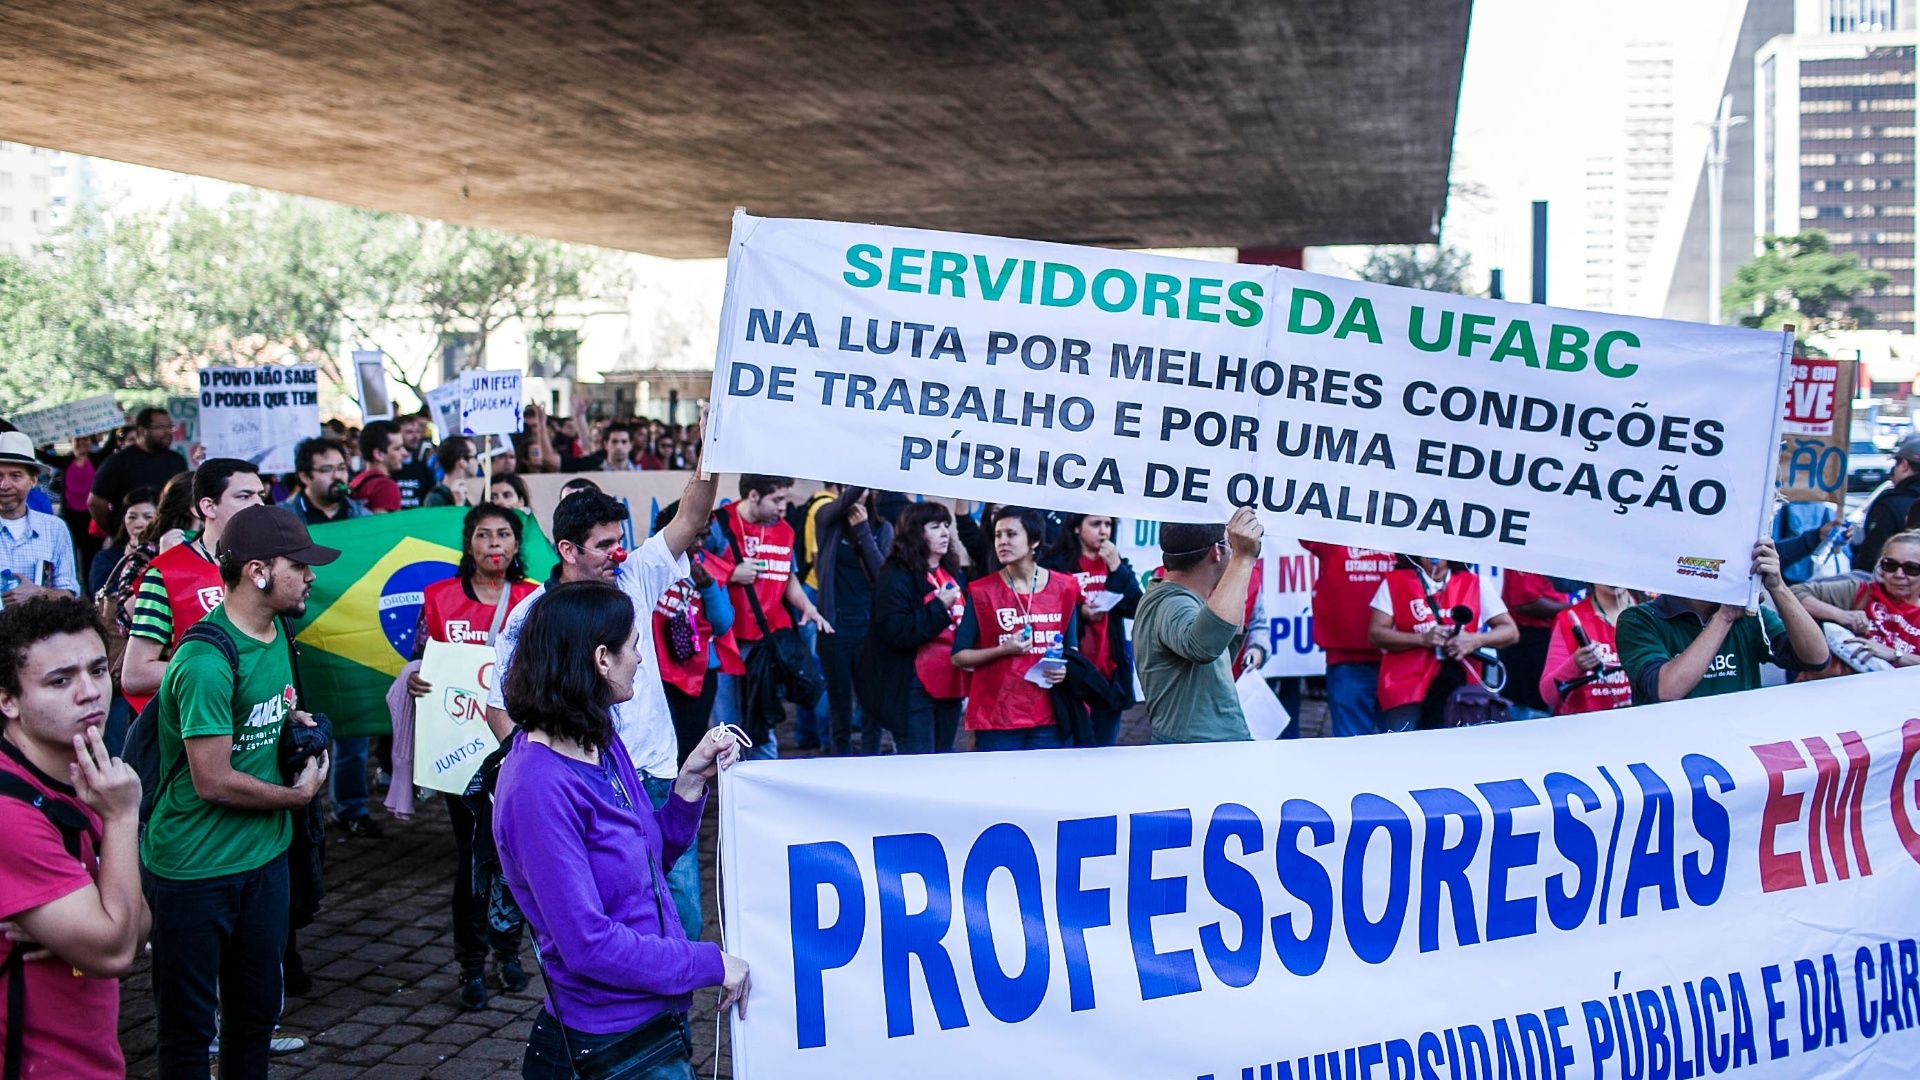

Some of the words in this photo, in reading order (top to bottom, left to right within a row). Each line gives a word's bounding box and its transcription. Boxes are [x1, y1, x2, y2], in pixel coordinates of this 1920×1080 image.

[843, 244, 1263, 327] SERVIDORES
[1288, 288, 1382, 344] DA
[1409, 306, 1640, 378] UFABC
[200, 370, 210, 387] O
[212, 370, 252, 387] POVO
[254, 365, 282, 386] NÃO
[285, 369, 317, 385] SABE
[472, 375, 519, 391] UNIFESP
[746, 308, 819, 347] NA
[839, 316, 966, 362] LUTA
[987, 331, 1091, 375] POR
[1110, 343, 1382, 409] MELHORES
[1403, 381, 1724, 456] CONDIÇÕES
[1812, 366, 1836, 381] em
[201, 391, 212, 407] O
[214, 391, 261, 408] PODER
[263, 390, 289, 409] QUE
[291, 390, 318, 405] TEM
[472, 397, 513, 411] DIADEMA
[728, 362, 796, 401] DE
[815, 371, 1094, 431] TRABALHO
[1114, 402, 1142, 438] E
[1160, 406, 1259, 452] POR
[1277, 420, 1395, 470] UMA
[1416, 439, 1726, 515] EDUCAÇÃO
[900, 430, 1124, 494] PÚBLICA
[1144, 463, 1210, 503] DE
[1227, 473, 1530, 545] QUALIDADE
[1775, 439, 1847, 493] ÃO
[384, 594, 421, 605] ORDEM
[434, 738, 485, 773] JUNTOS
[788, 754, 1736, 1049] PROFESSORES/AS
[1759, 753, 1872, 893] EM
[1581, 971, 1757, 1080] PÚBLICA
[1761, 964, 1789, 1060] E
[1794, 954, 1849, 1052] DA
